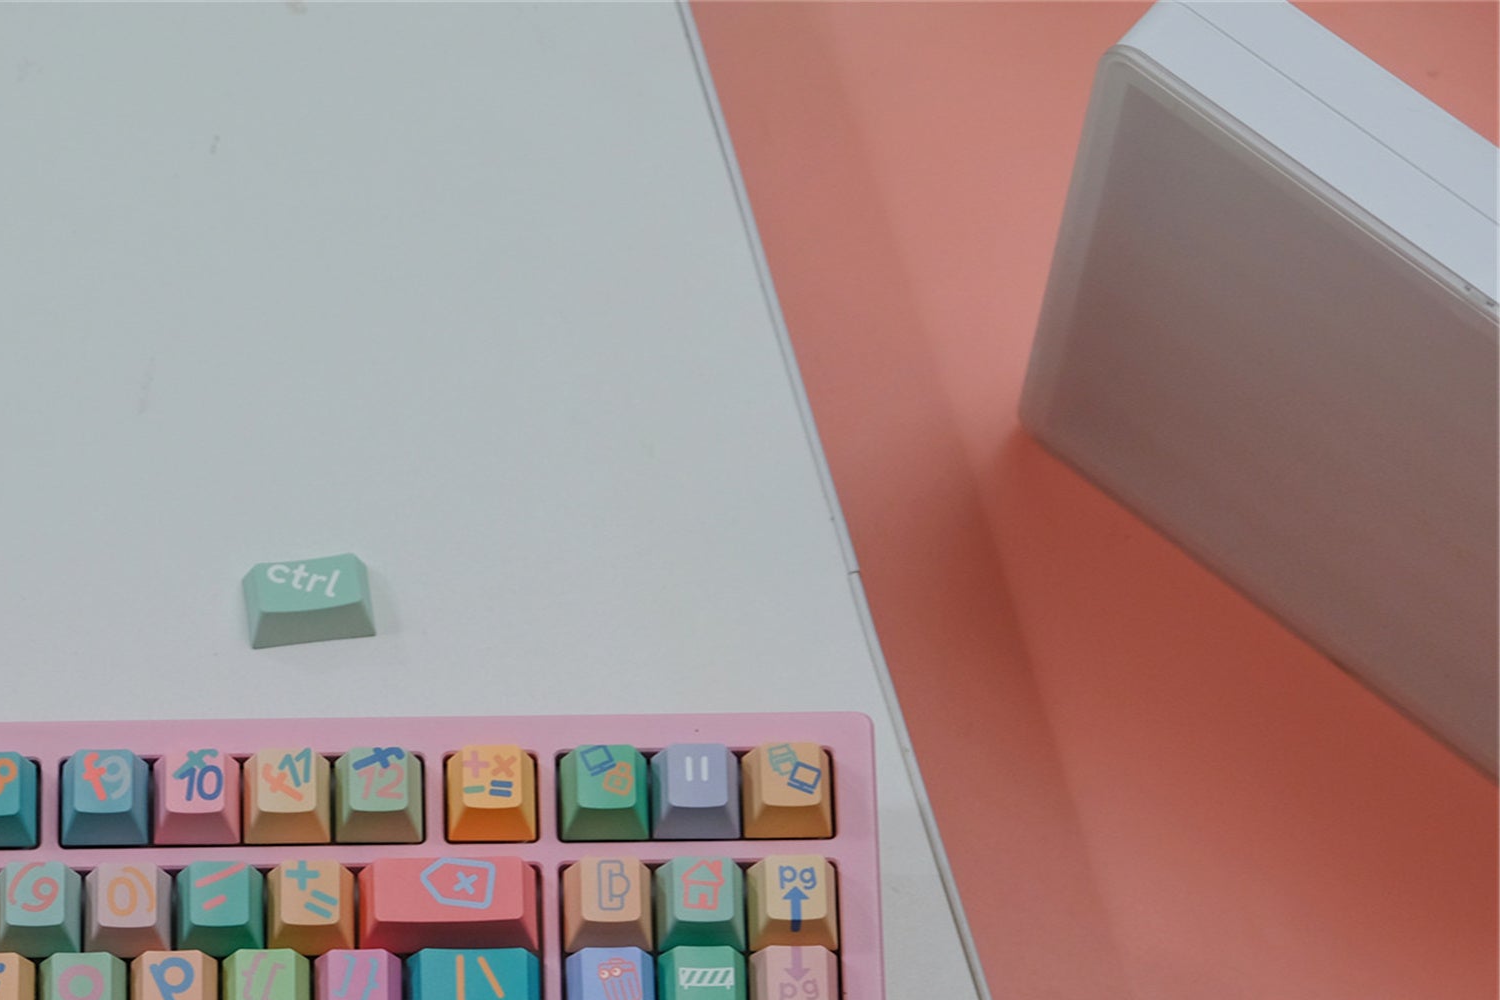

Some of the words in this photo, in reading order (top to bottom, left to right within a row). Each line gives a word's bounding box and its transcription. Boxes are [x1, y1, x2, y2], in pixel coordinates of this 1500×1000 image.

[266, 564, 341, 598] ctrl
[82, 752, 132, 801] f9
[262, 747, 312, 802] f11
[779, 865, 818, 890] pg
